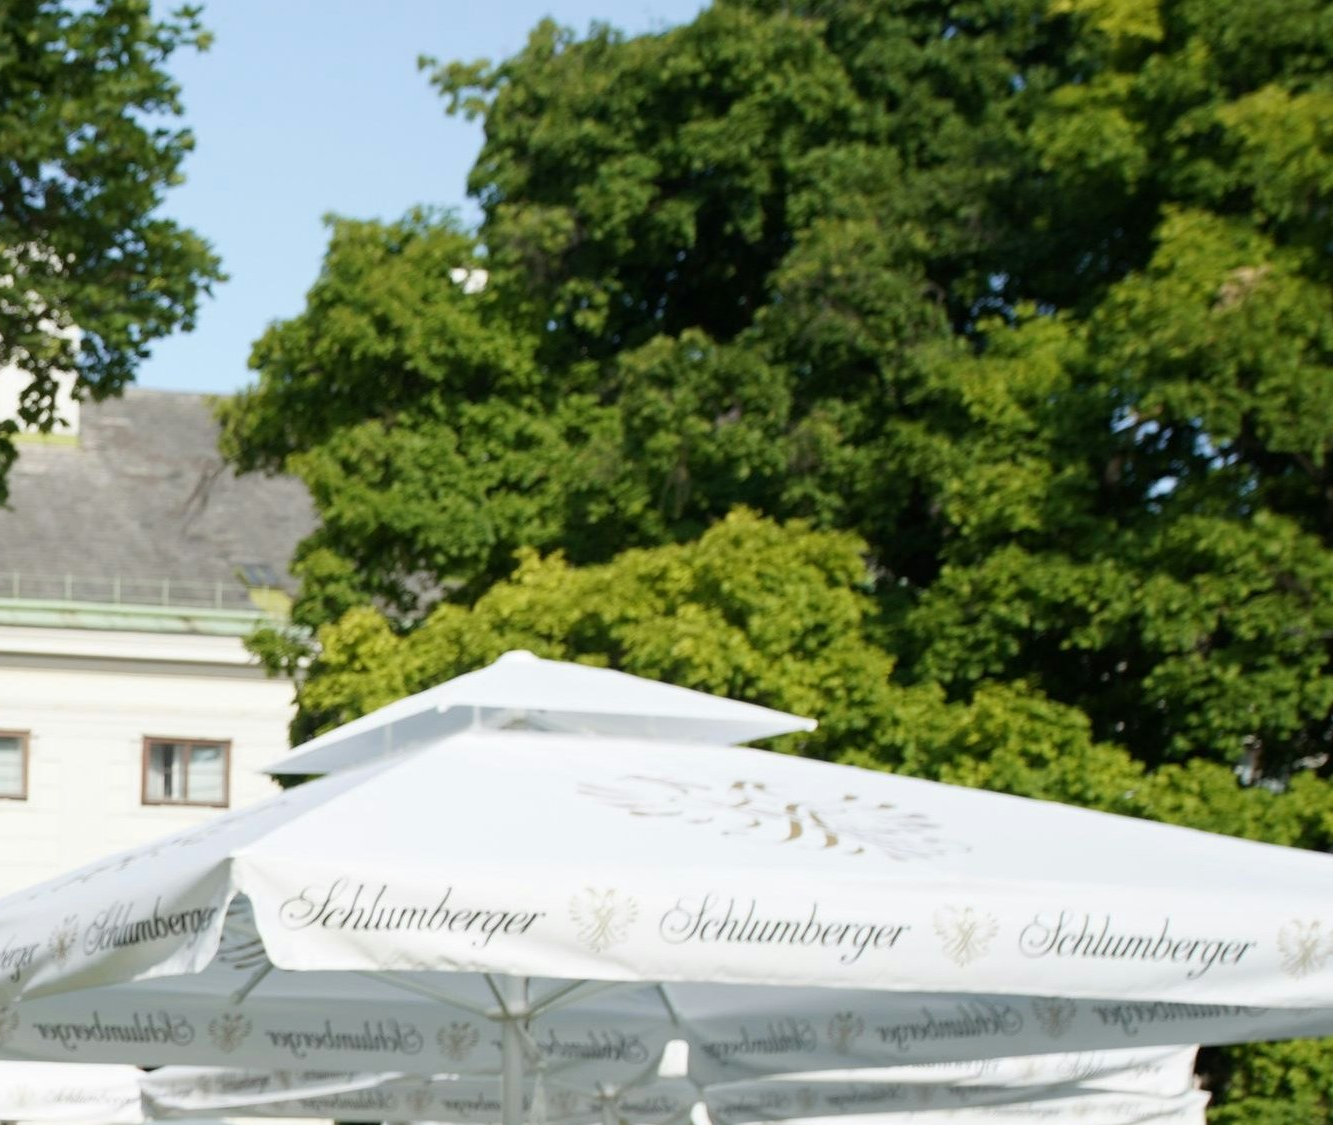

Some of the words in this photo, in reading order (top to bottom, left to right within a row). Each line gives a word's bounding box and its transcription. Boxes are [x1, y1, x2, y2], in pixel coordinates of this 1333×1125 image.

[83, 896, 218, 957] Schlumberger
[279, 877, 547, 947] Schlumberger
[659, 894, 911, 963] Schlumberger
[1018, 909, 1257, 979] Schlumberger
